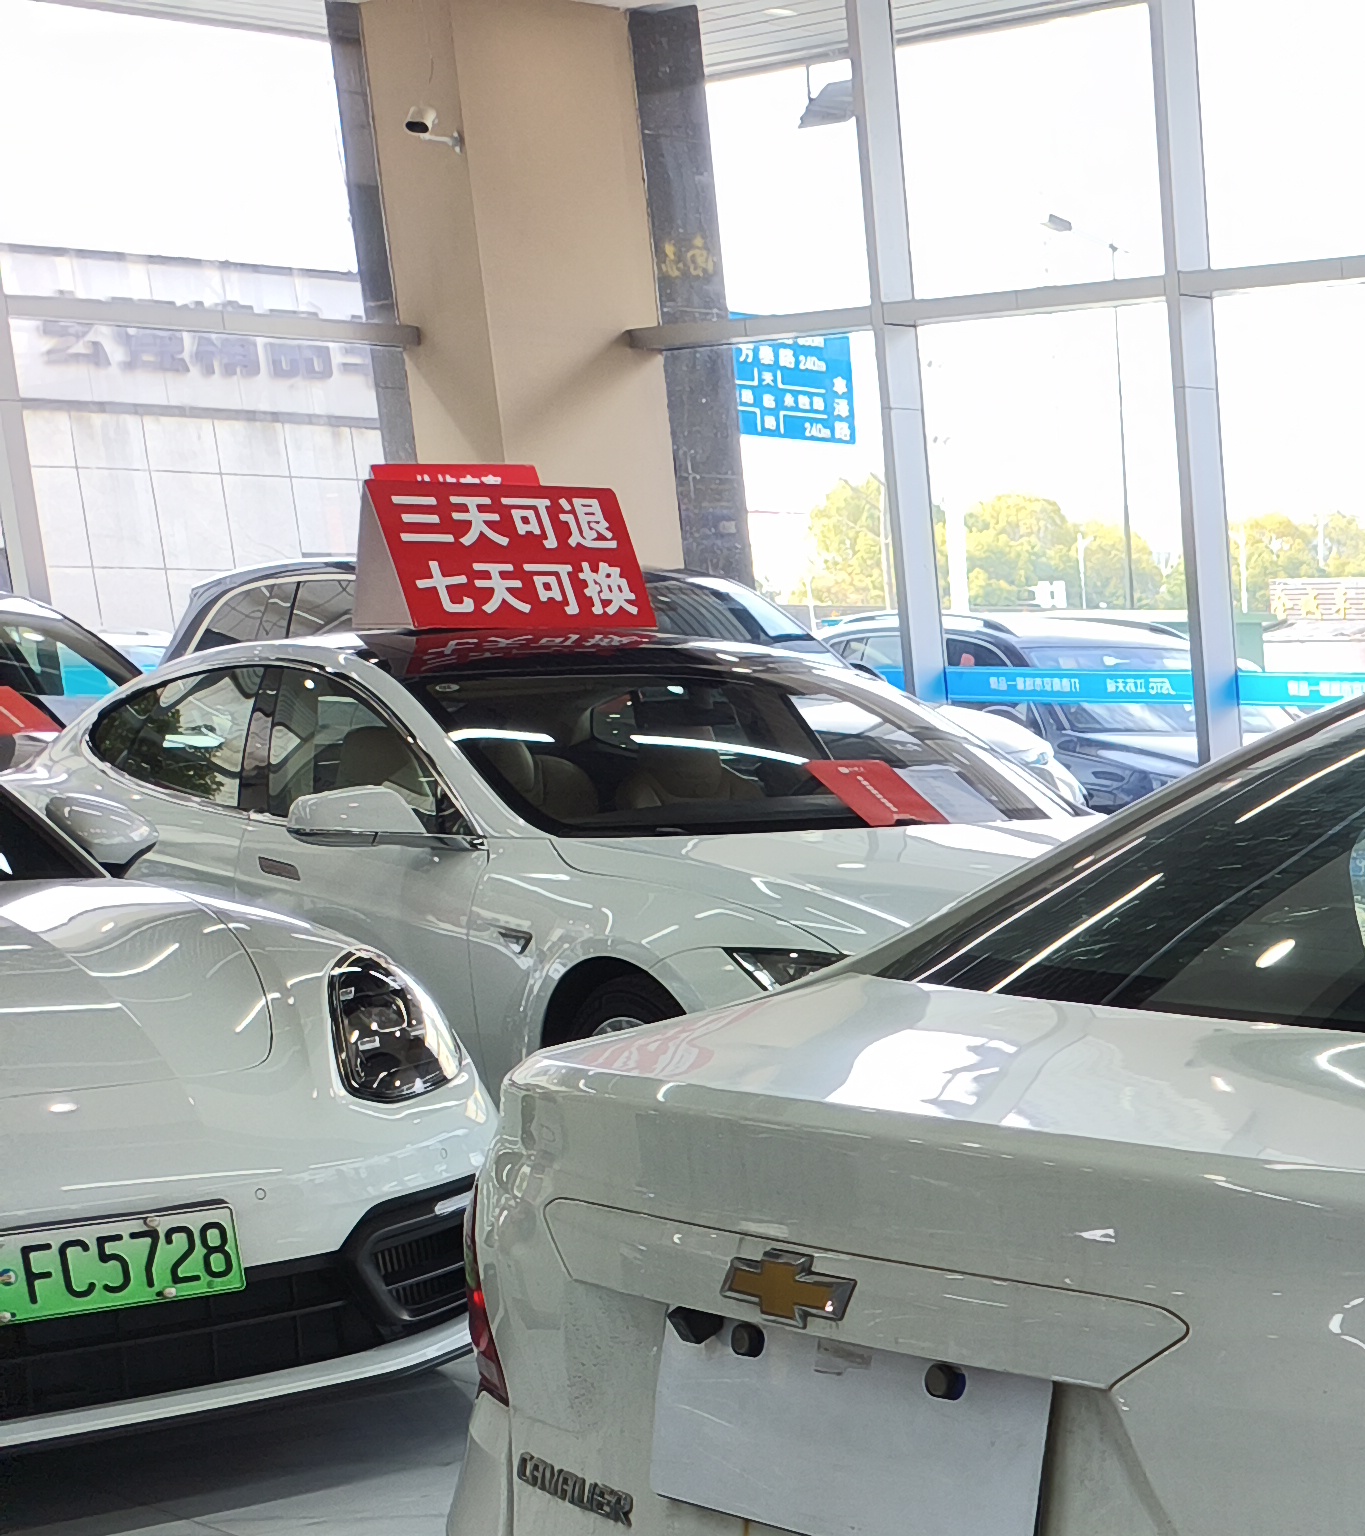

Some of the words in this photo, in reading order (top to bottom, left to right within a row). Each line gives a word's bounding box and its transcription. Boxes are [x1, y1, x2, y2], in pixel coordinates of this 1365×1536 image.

[391, 496, 618, 549] 三天可退
[416, 561, 639, 615] 七天可换
[21, 1221, 233, 1305] FC5728
[516, 1451, 634, 1528] CAVALIER
